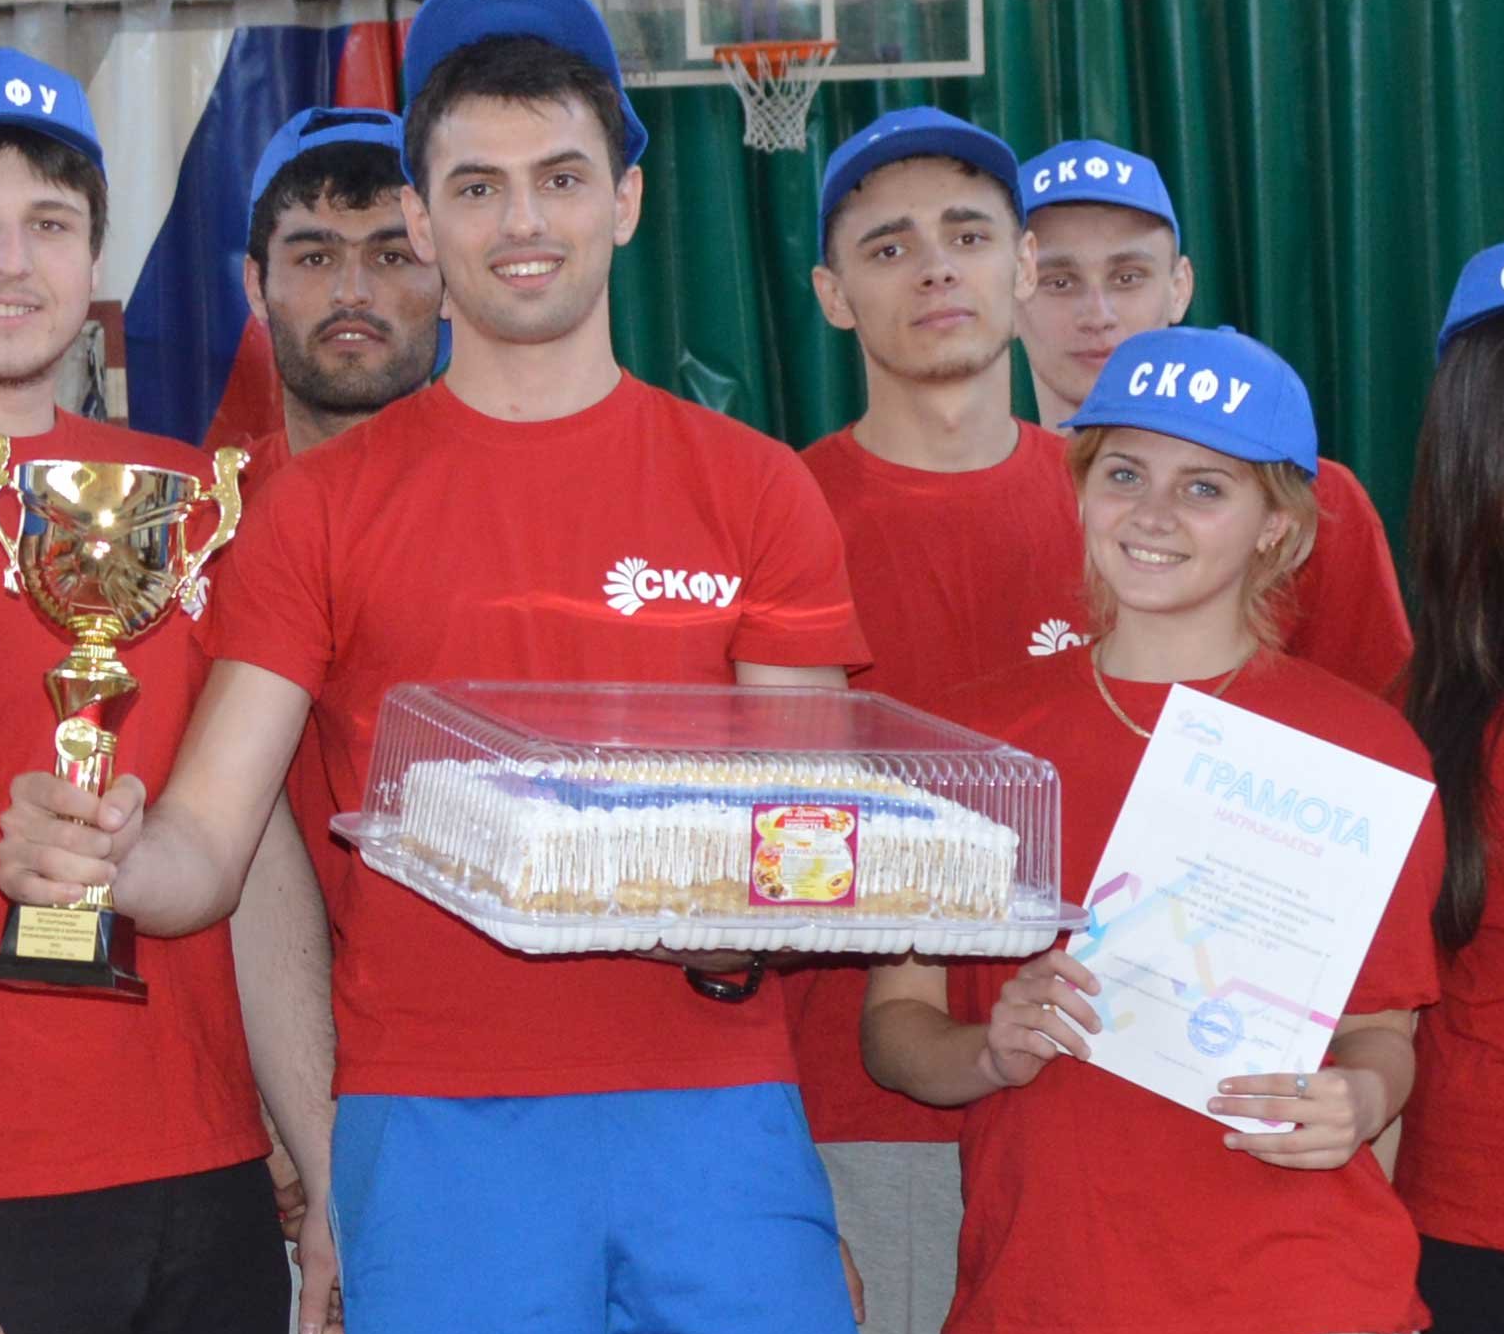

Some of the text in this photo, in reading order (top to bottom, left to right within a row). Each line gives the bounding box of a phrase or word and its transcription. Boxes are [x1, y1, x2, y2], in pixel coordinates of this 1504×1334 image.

[1033, 156, 1133, 193] СКФУ
[1128, 362, 1252, 414] СКФУ
[634, 568, 742, 608] СКФУ
[1183, 752, 1370, 856] ГРАМОТА
